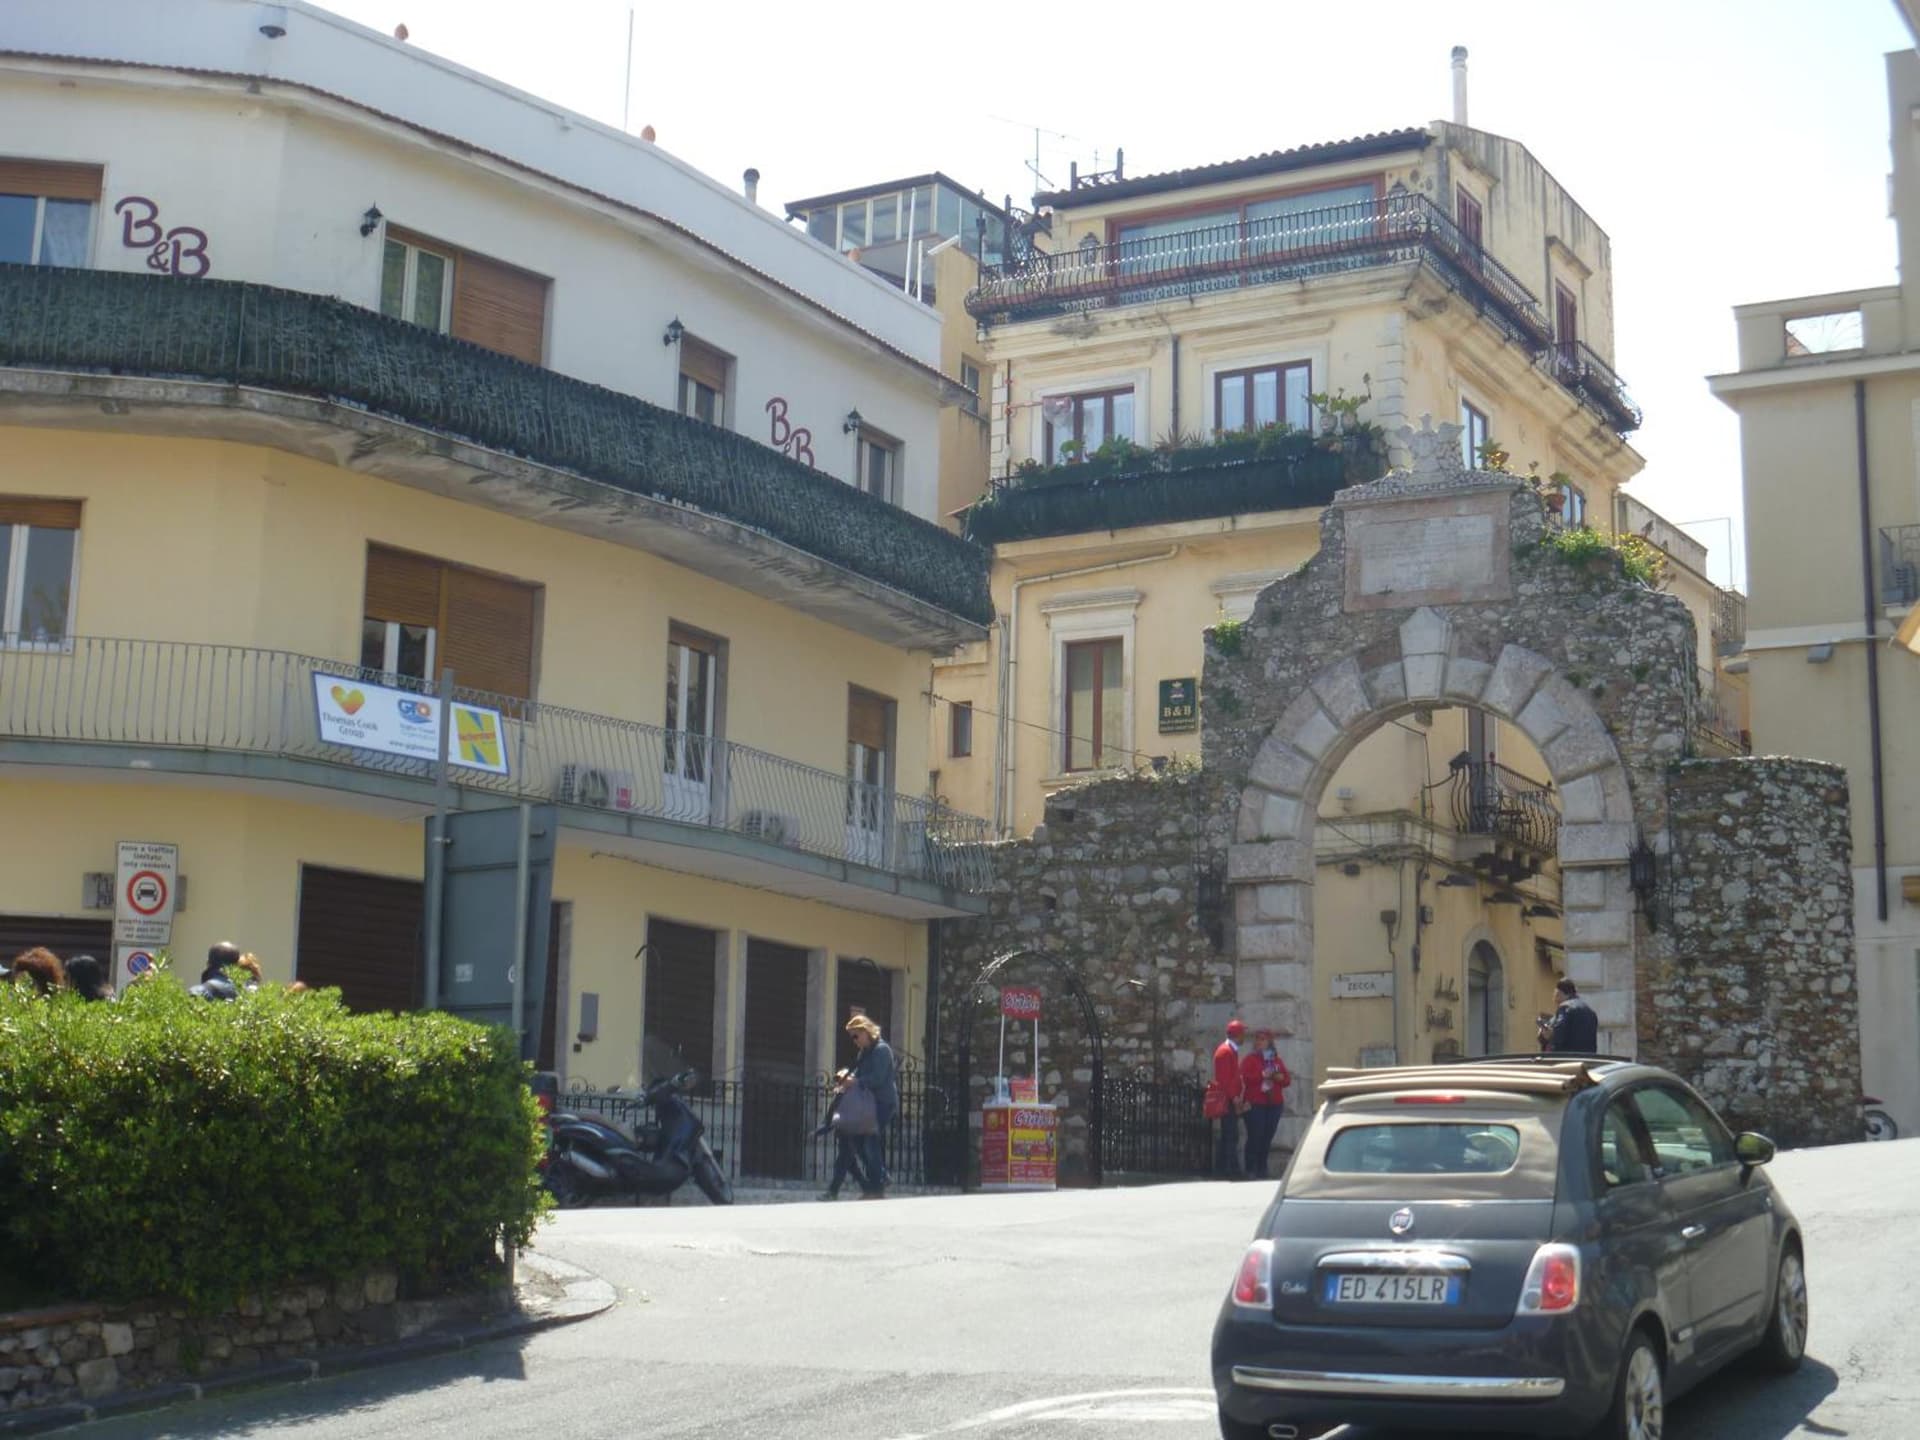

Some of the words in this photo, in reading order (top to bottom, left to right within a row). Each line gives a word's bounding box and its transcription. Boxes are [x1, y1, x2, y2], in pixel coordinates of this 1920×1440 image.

[114, 195, 211, 278] B&B
[357, 718, 379, 731] Cook
[1340, 1277, 1366, 1300] ED
[1374, 1275, 1445, 1301] 415LR
